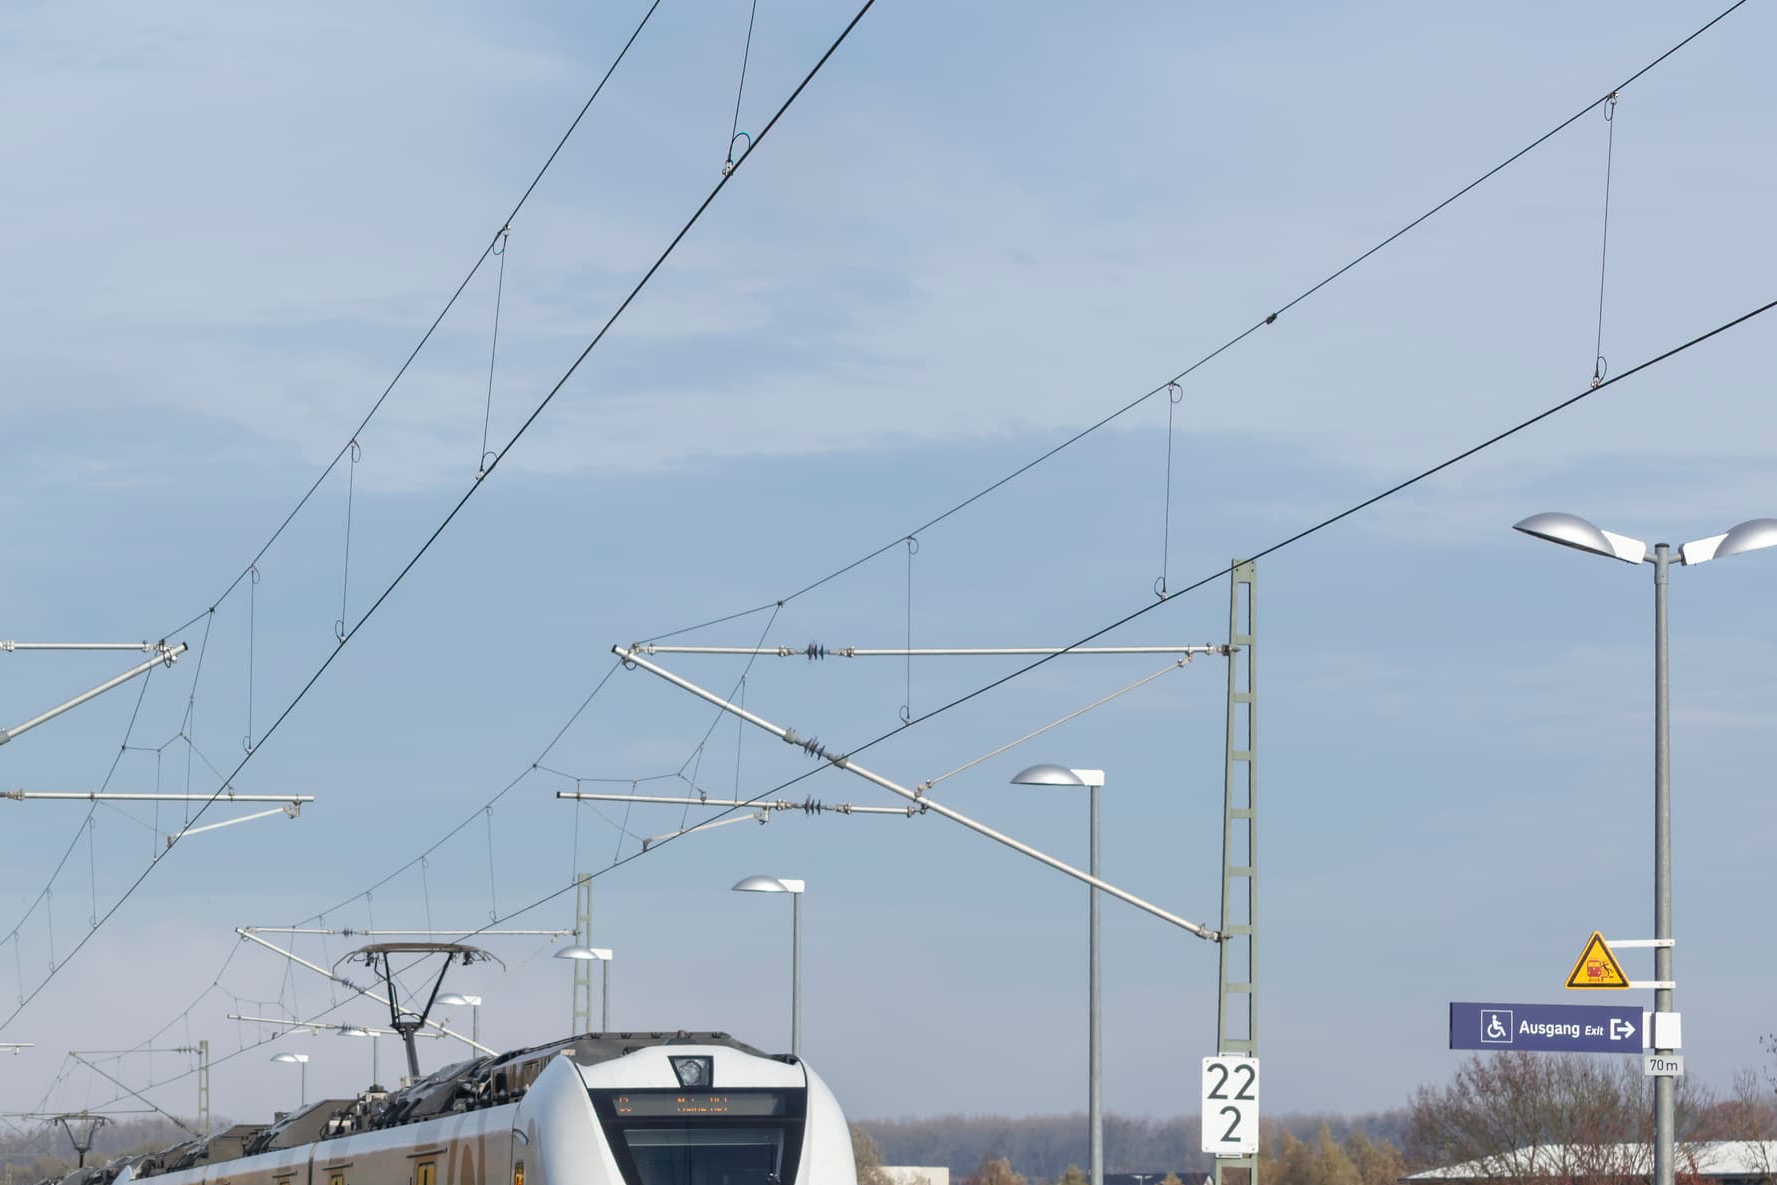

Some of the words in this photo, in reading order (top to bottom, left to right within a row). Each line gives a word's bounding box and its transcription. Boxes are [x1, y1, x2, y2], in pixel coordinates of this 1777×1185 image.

[1519, 1020, 1580, 1037] Ausgang
[1584, 1025, 1604, 1036] Exit
[1650, 1059, 1664, 1071] 70
[1666, 1062, 1678, 1071] m
[1207, 1063, 1255, 1100] 22
[1220, 1105, 1241, 1142] 2
